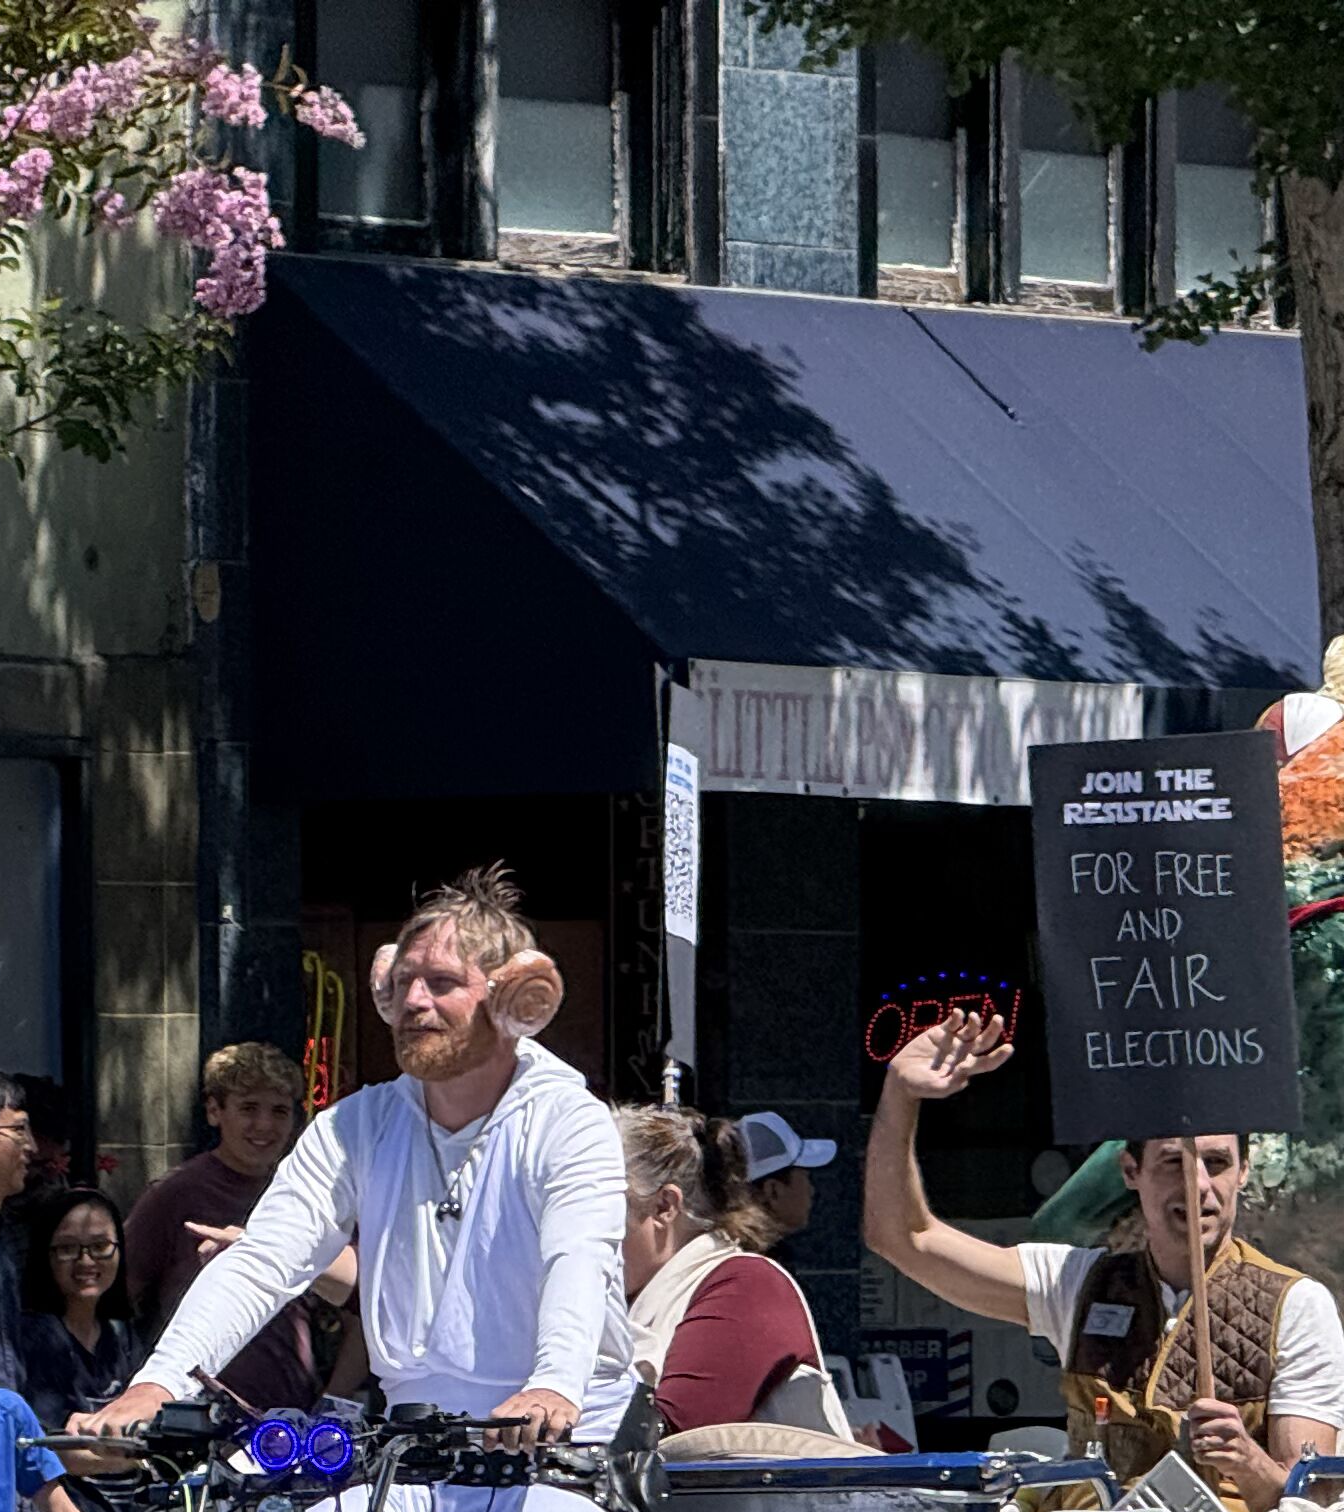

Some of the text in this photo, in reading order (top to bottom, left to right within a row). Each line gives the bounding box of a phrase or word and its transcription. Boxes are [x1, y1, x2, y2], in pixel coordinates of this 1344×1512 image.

[1081, 769, 1215, 794] JOIN THE
[1063, 798, 1233, 825] RESISTANCE
[1070, 851, 1235, 896] FOR FREE
[1116, 907, 1183, 946] AND
[1090, 954, 1227, 1010] FAIR
[1085, 1027, 1265, 1069] ELECTIONS
